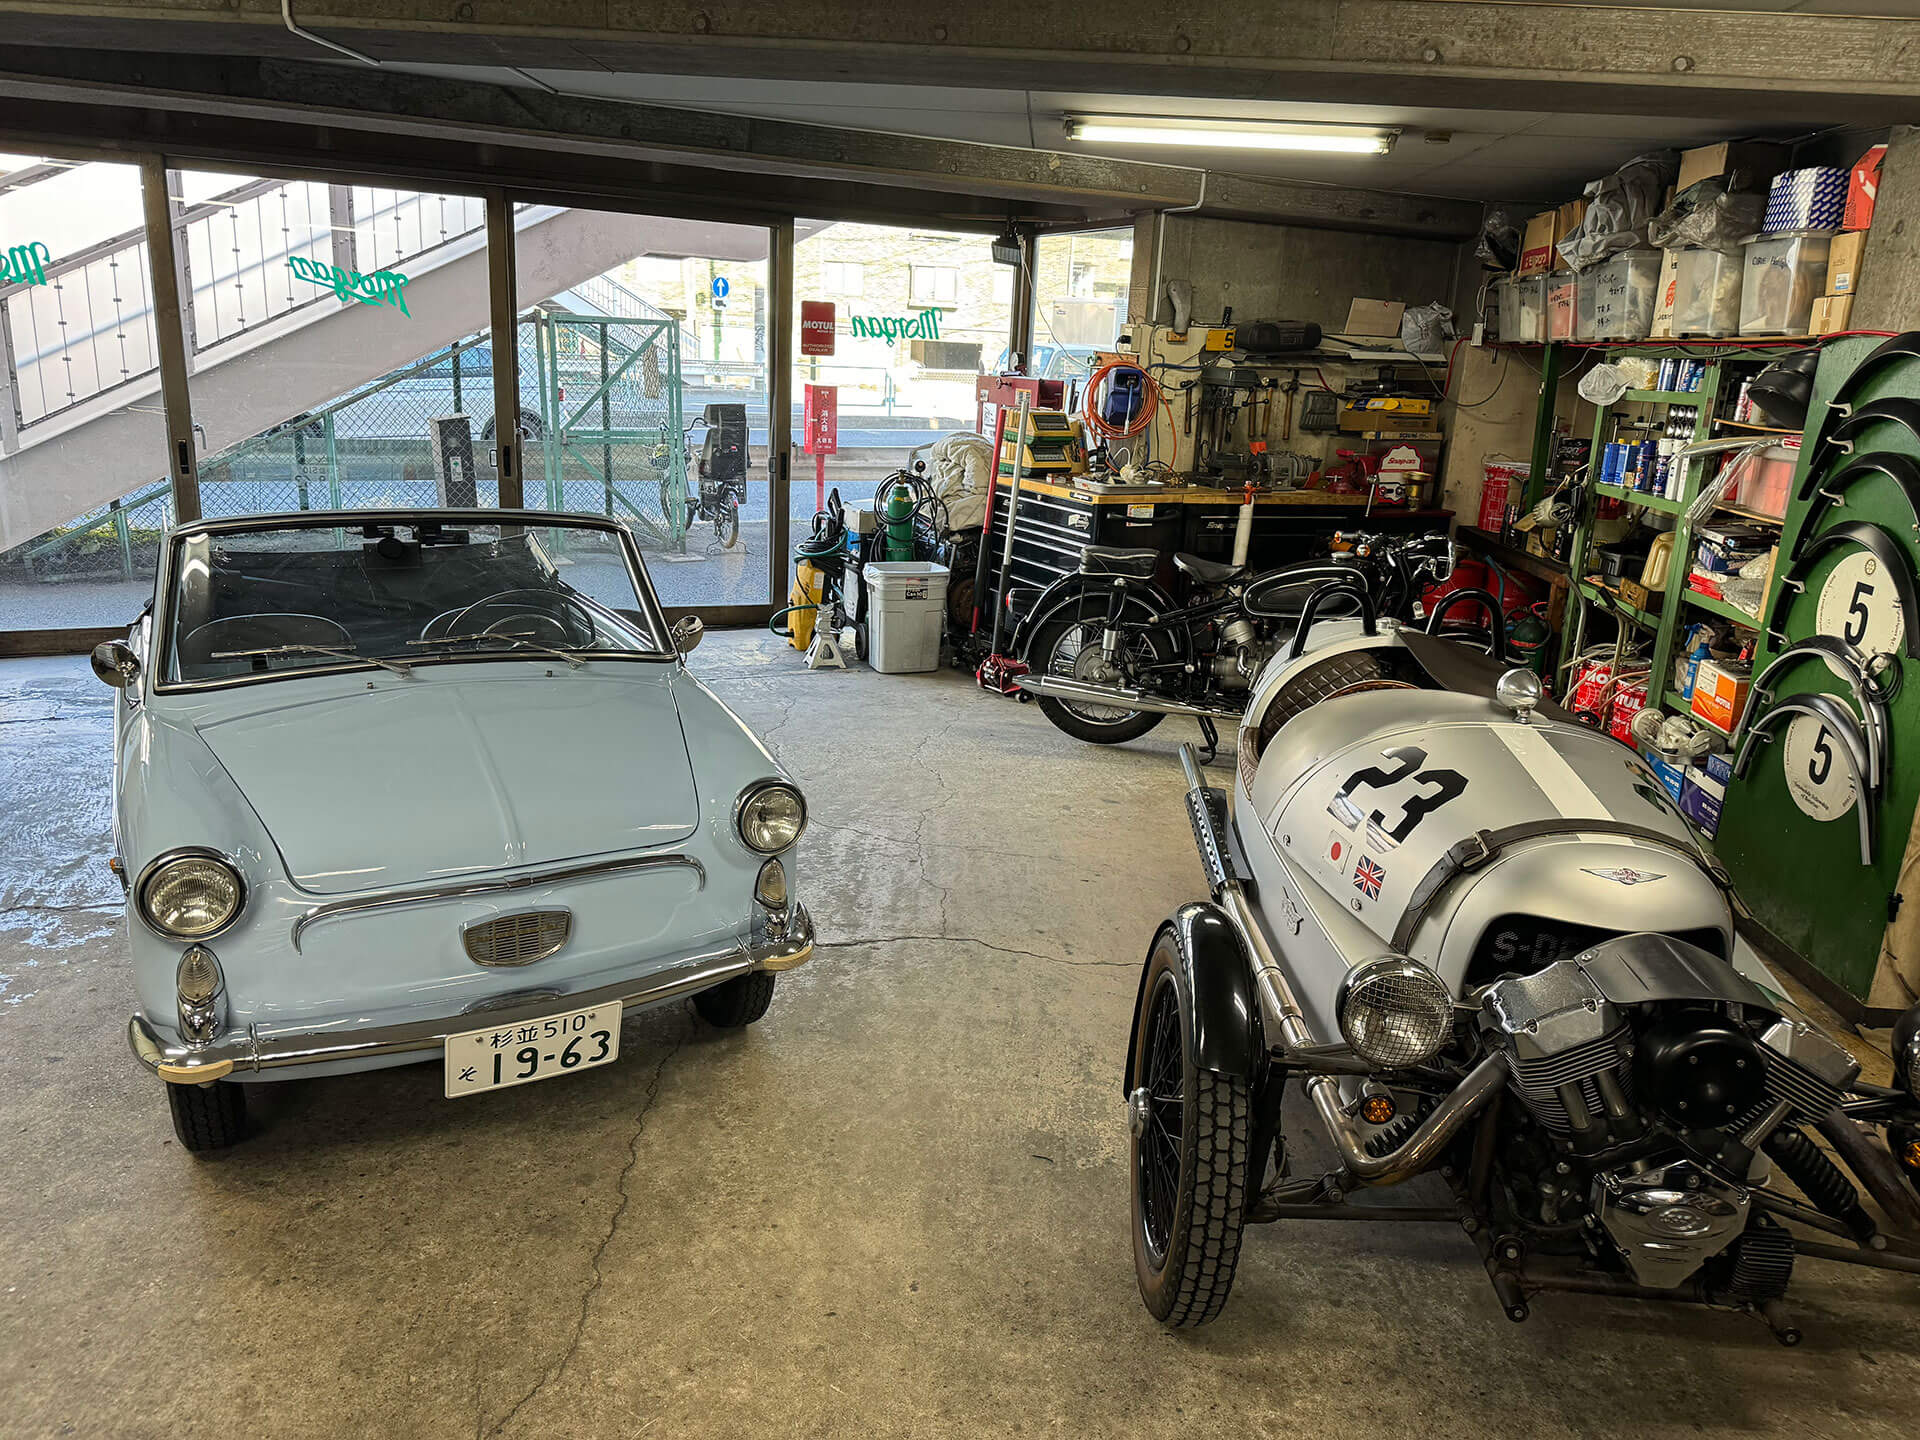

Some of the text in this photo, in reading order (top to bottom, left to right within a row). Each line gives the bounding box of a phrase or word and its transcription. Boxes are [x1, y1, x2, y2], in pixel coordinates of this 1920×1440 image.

[802, 320, 834, 330] MOTUL
[1223, 332, 1234, 349] 5
[1387, 457, 1416, 465] Snap-on
[1844, 581, 1874, 646] 5
[1808, 724, 1835, 785] 5
[1326, 746, 1469, 854] 23
[490, 1014, 586, 1049] 杉並 510
[493, 1030, 611, 1085] 19-63
